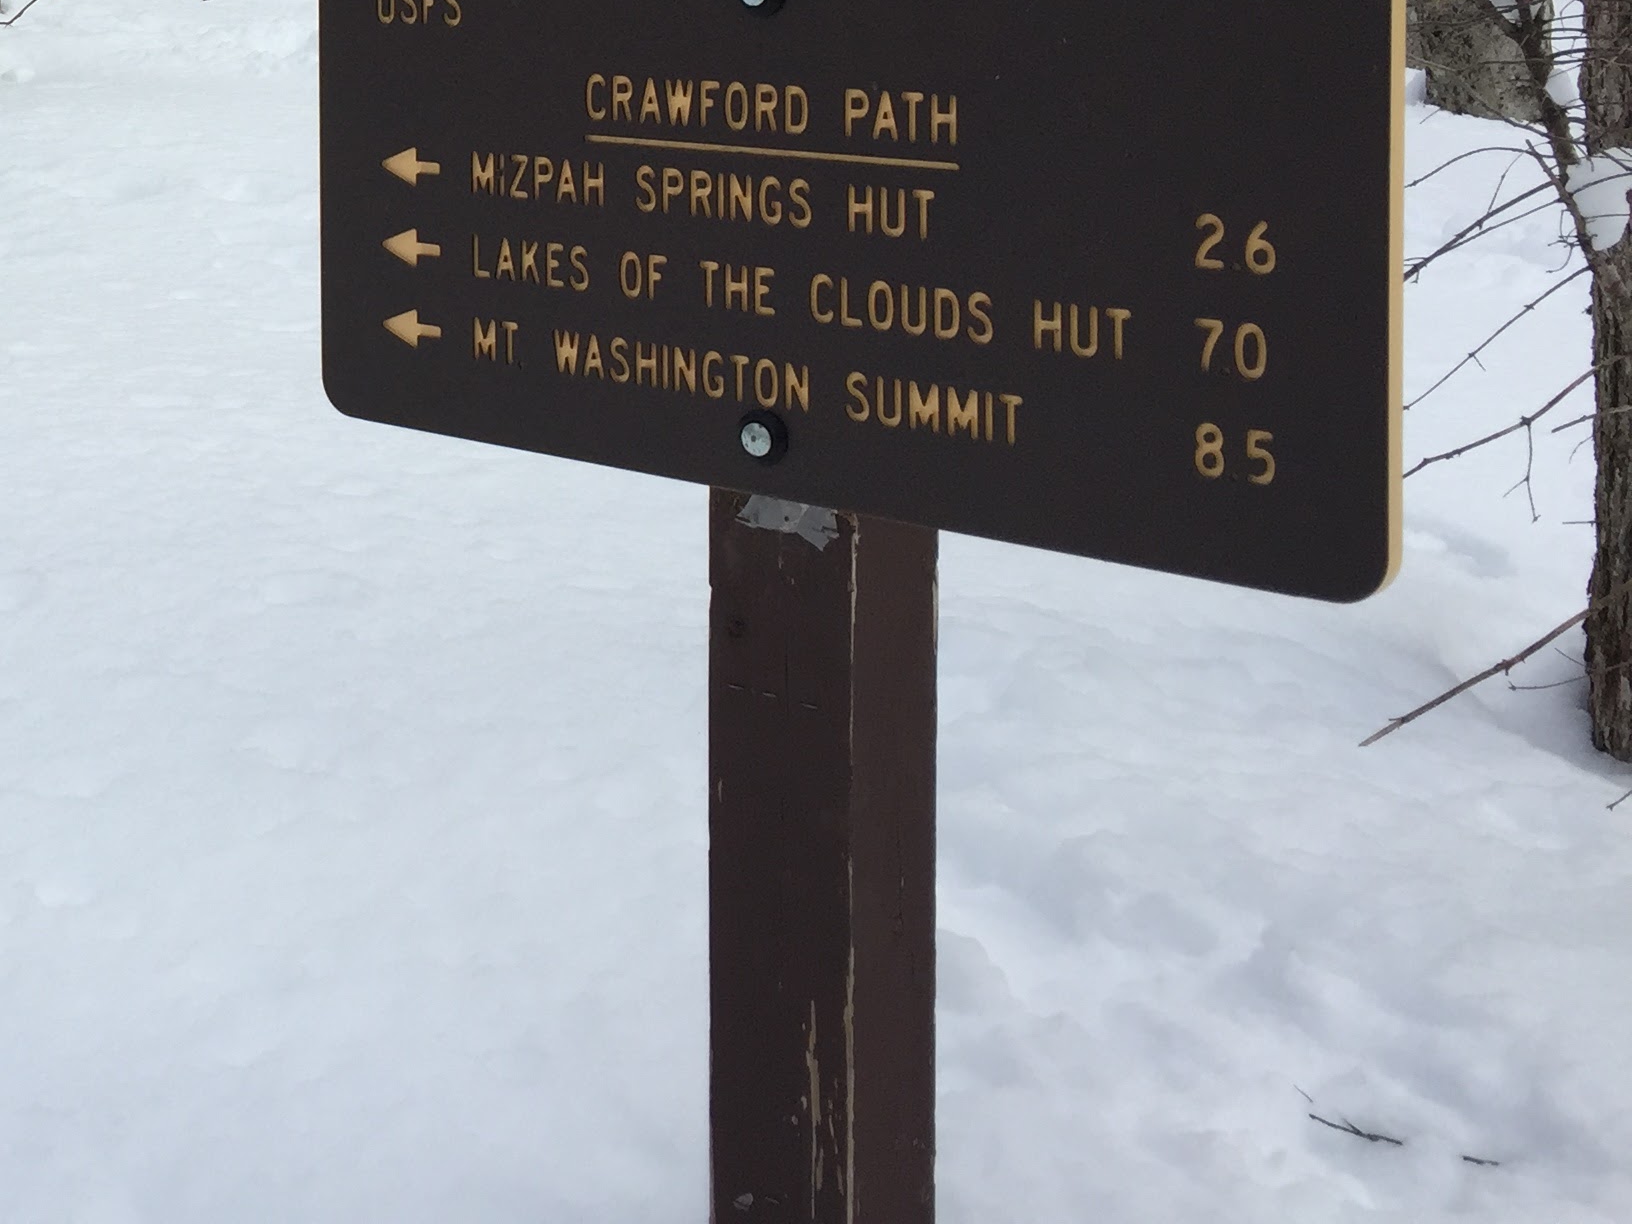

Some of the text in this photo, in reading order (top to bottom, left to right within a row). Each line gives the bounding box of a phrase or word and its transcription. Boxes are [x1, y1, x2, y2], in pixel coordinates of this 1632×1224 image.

[586, 73, 957, 144] CRAWFORD PATH
[472, 151, 935, 238] MIZPAH SPRINGS HUT
[474, 238, 1131, 358] LAKES OF THE CLOUDS HUT
[554, 331, 809, 411] WASHINGTON
[846, 371, 1023, 443] SUMMIT
